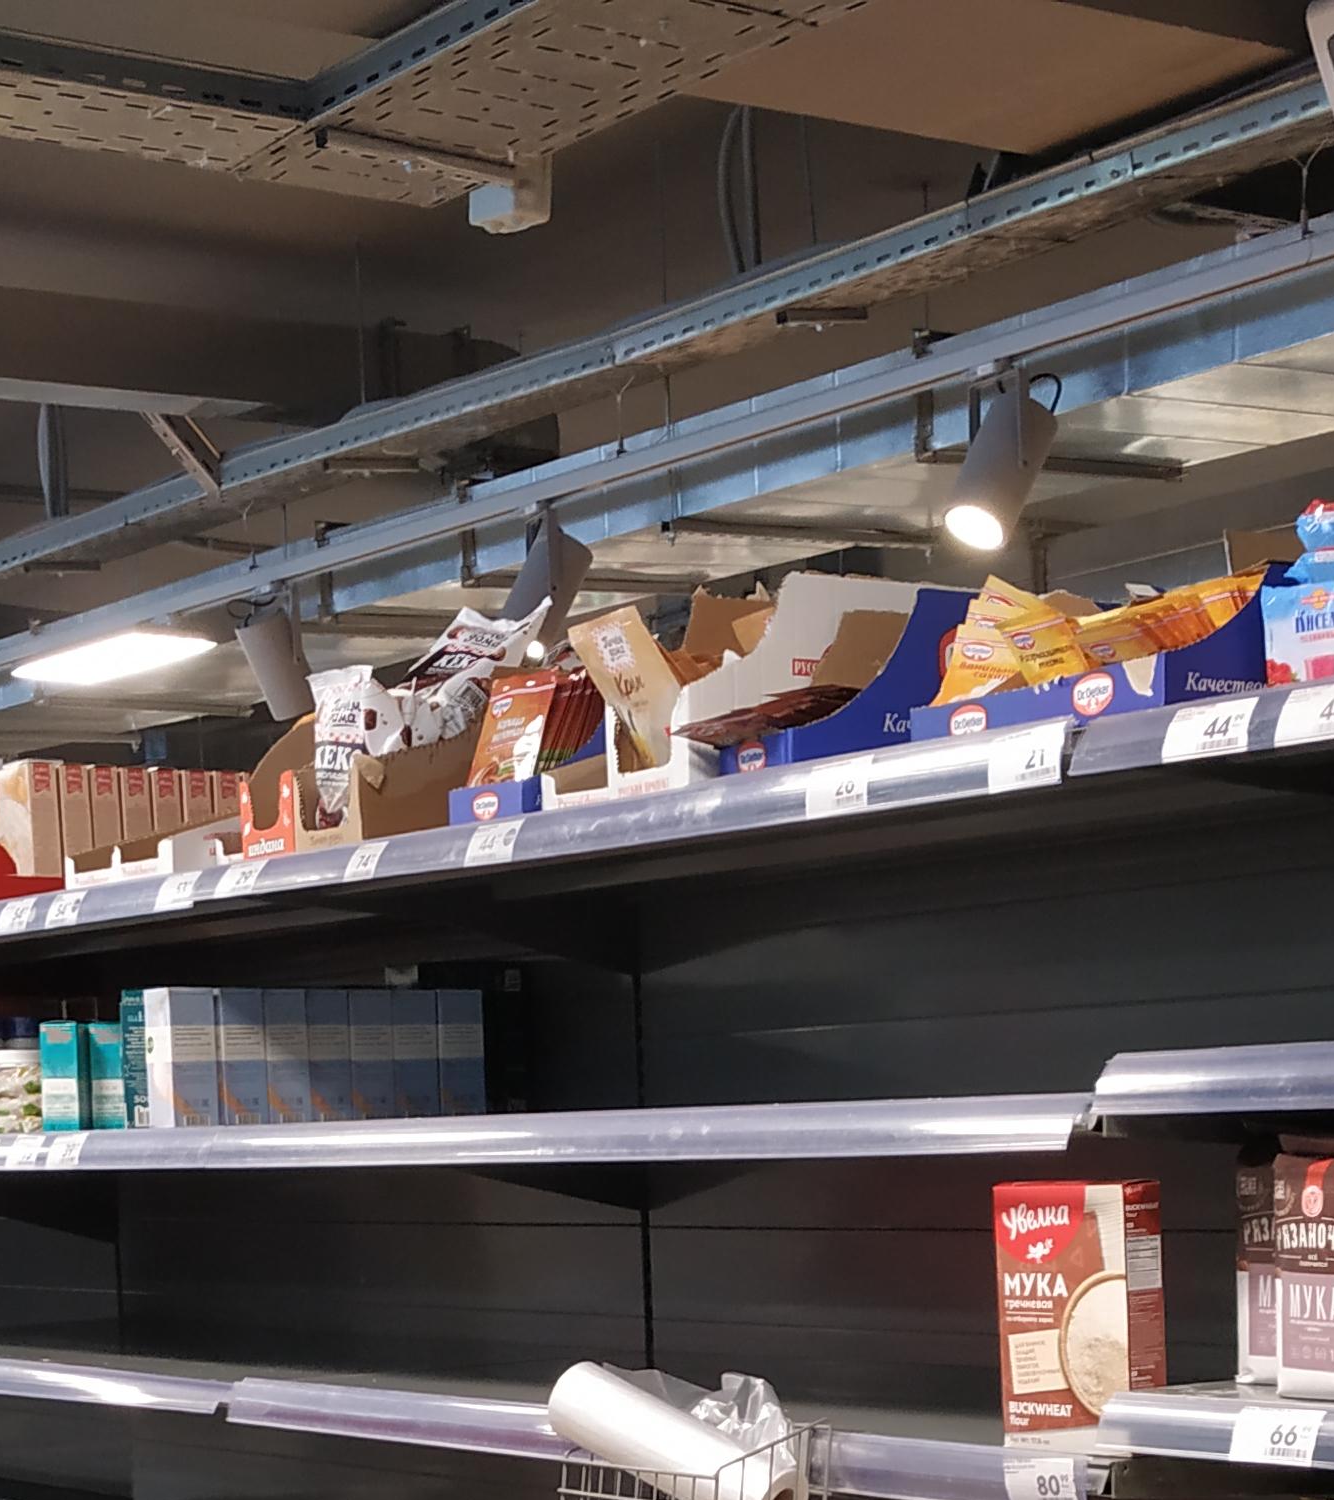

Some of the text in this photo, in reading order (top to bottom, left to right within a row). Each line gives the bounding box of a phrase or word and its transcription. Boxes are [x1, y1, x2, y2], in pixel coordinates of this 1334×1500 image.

[1003, 1272, 1069, 1298] МУКА
[1008, 1400, 1074, 1418] BUCKWHEAT
[1270, 1425, 1298, 1447] 66
[1036, 1474, 1061, 1497] 80
